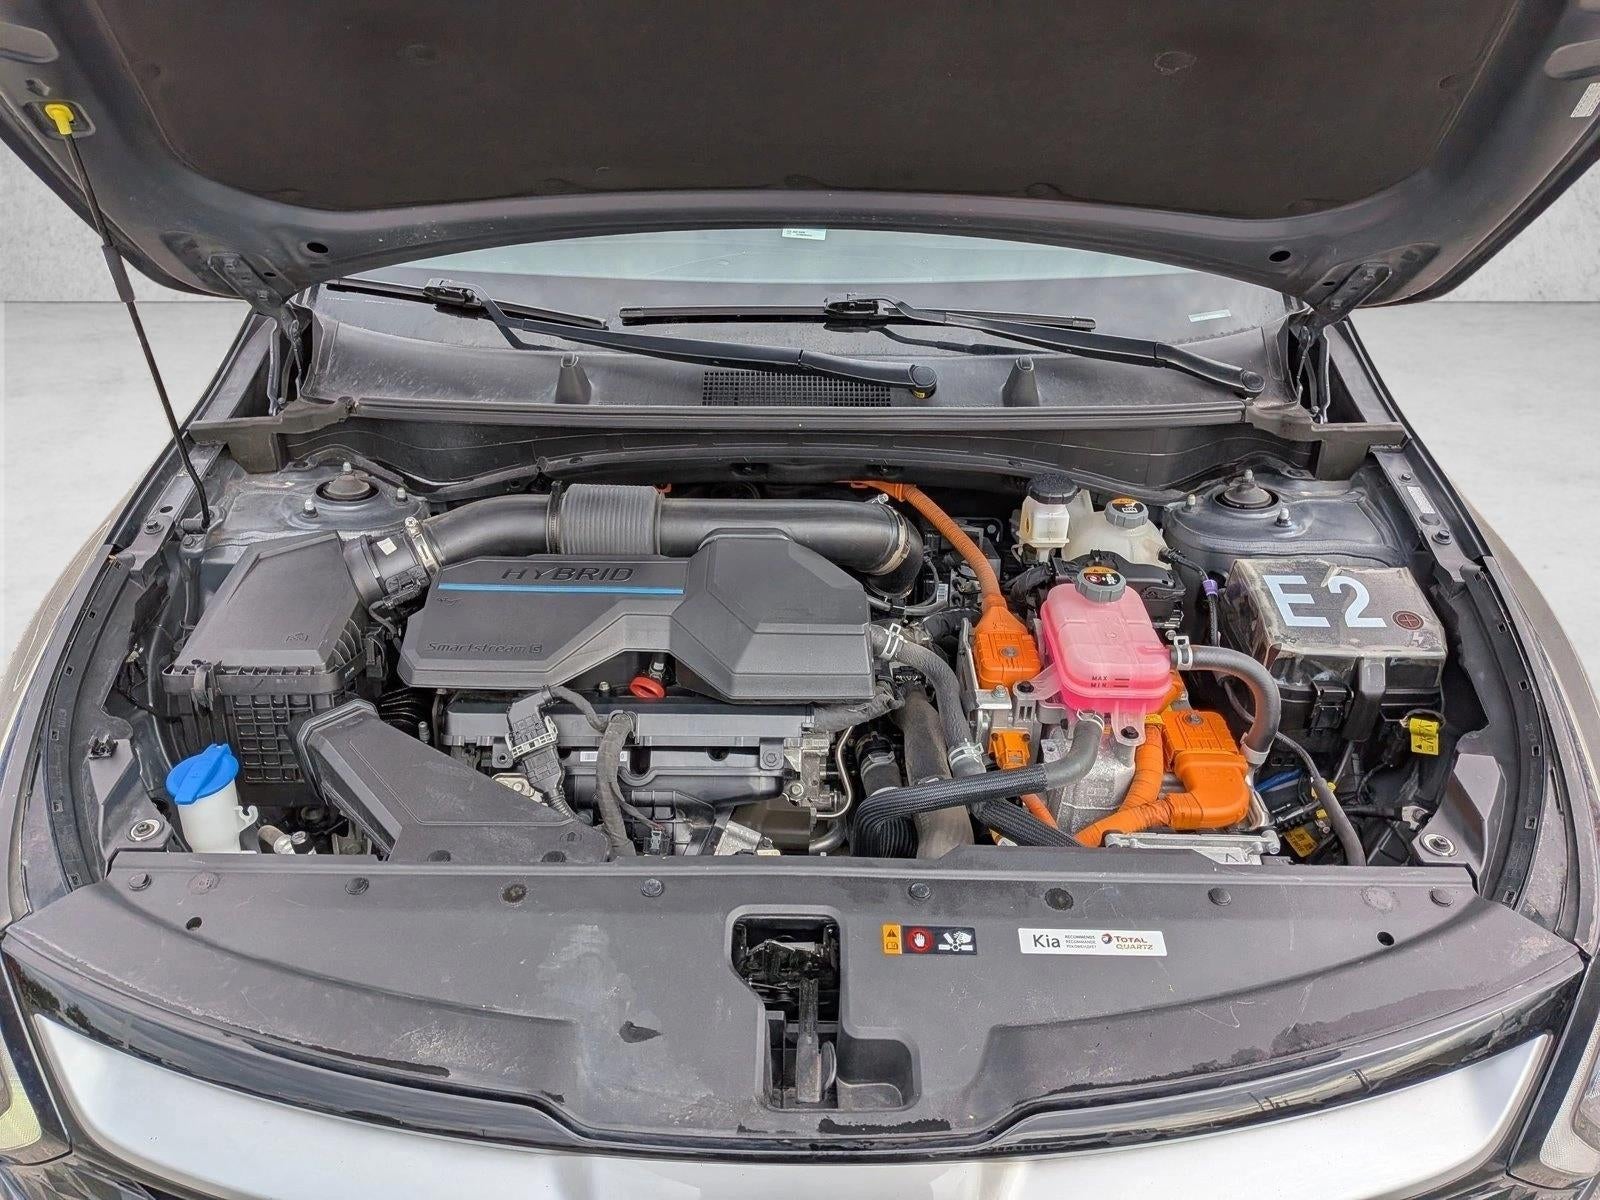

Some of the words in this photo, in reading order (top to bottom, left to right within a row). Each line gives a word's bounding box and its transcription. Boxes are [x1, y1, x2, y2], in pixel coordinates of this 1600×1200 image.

[501, 567, 635, 582] HYBRID
[428, 642, 527, 653] Smartstream
[1032, 934, 1061, 948] Kia
[1113, 935, 1148, 944] TOTAL
